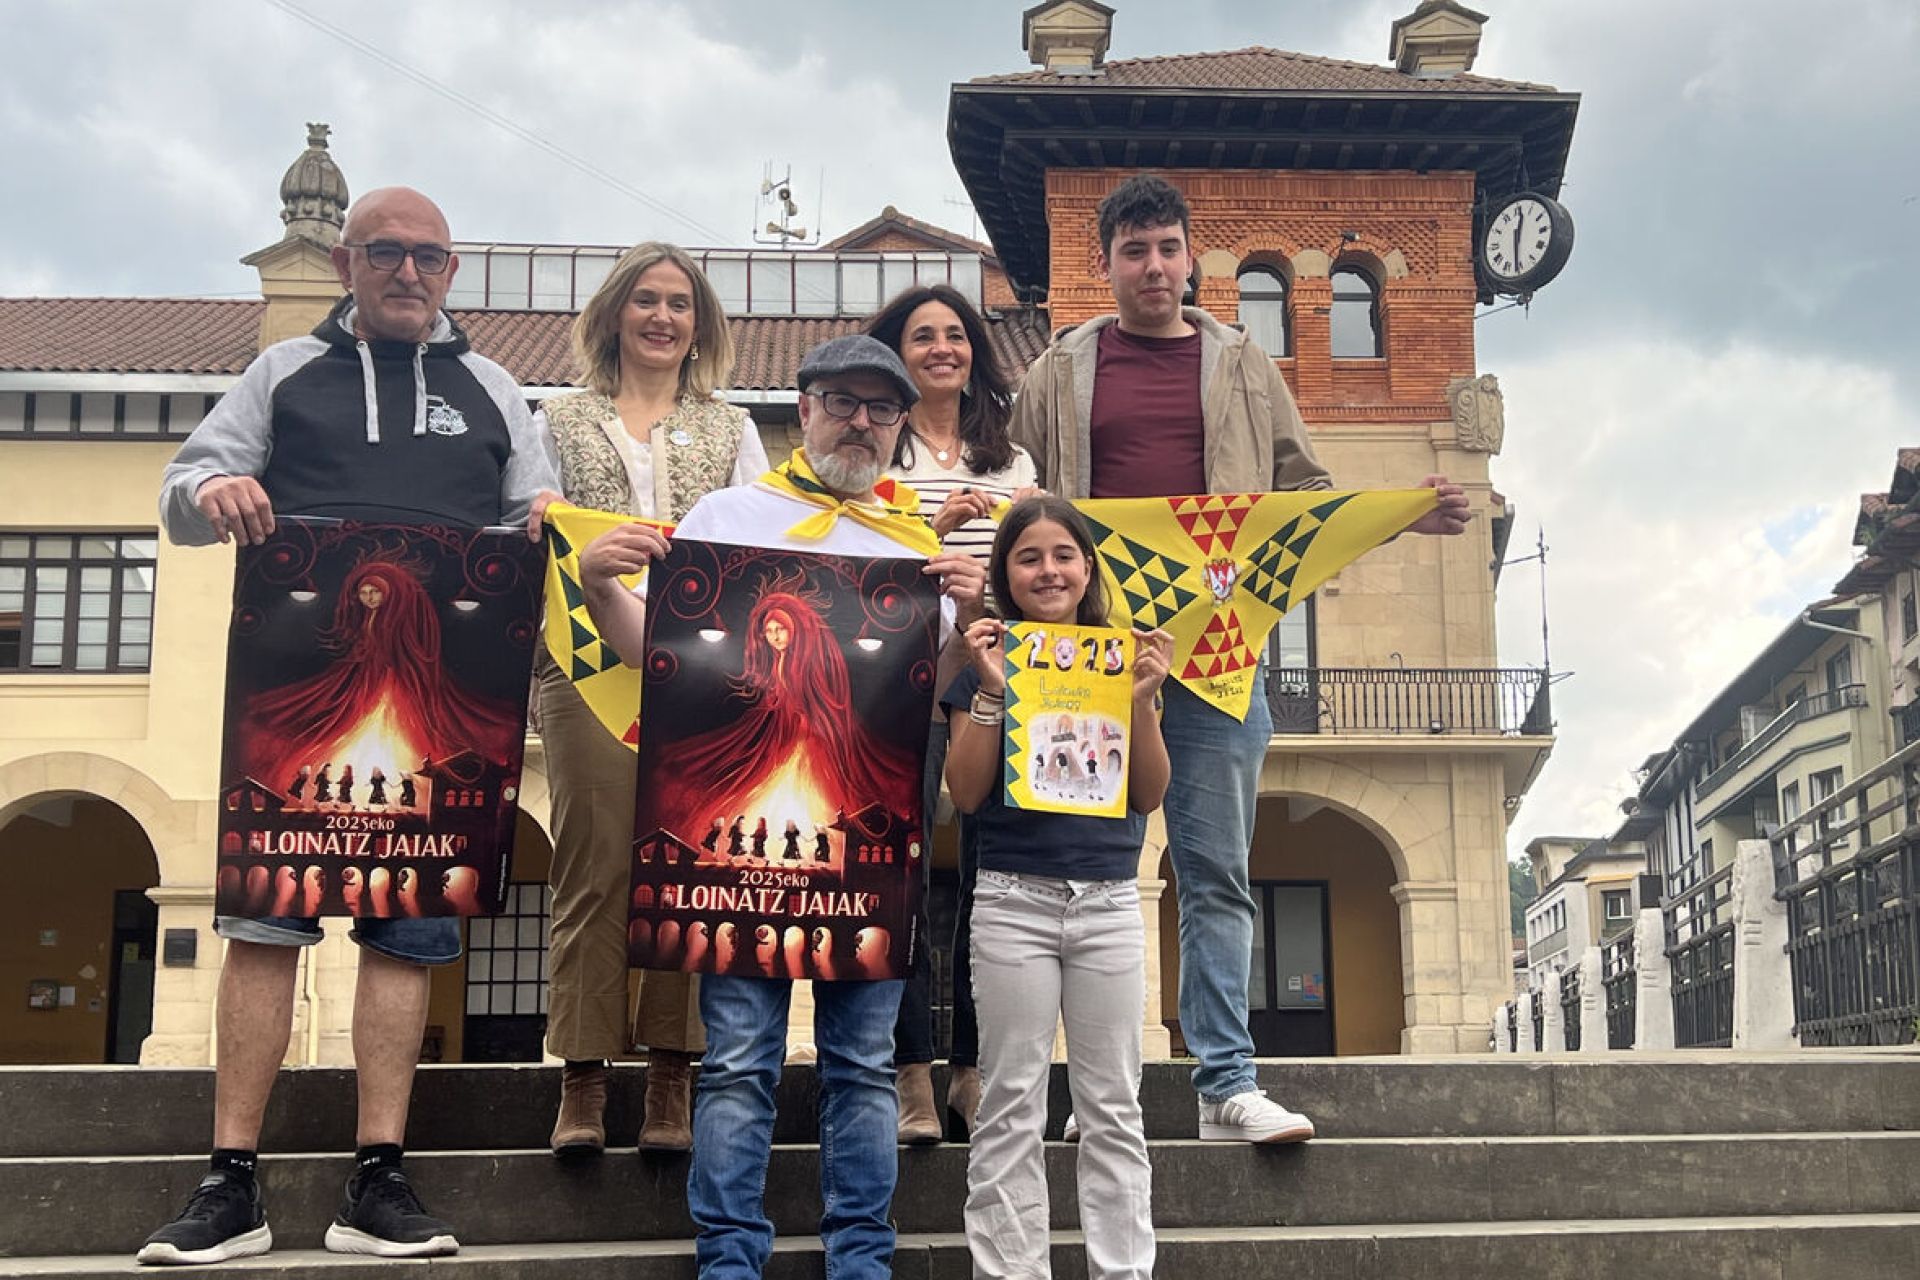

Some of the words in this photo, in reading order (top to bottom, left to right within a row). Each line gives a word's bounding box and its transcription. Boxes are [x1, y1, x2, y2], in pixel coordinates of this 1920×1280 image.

[1022, 630, 1125, 676] 2025
[325, 815, 395, 831] 2025eko
[264, 831, 371, 856] LOINATZ
[378, 833, 455, 859] JAIAK
[739, 869, 809, 888] 2025eko
[676, 884, 785, 914] LOINATZ
[793, 890, 870, 917] JAIAK
